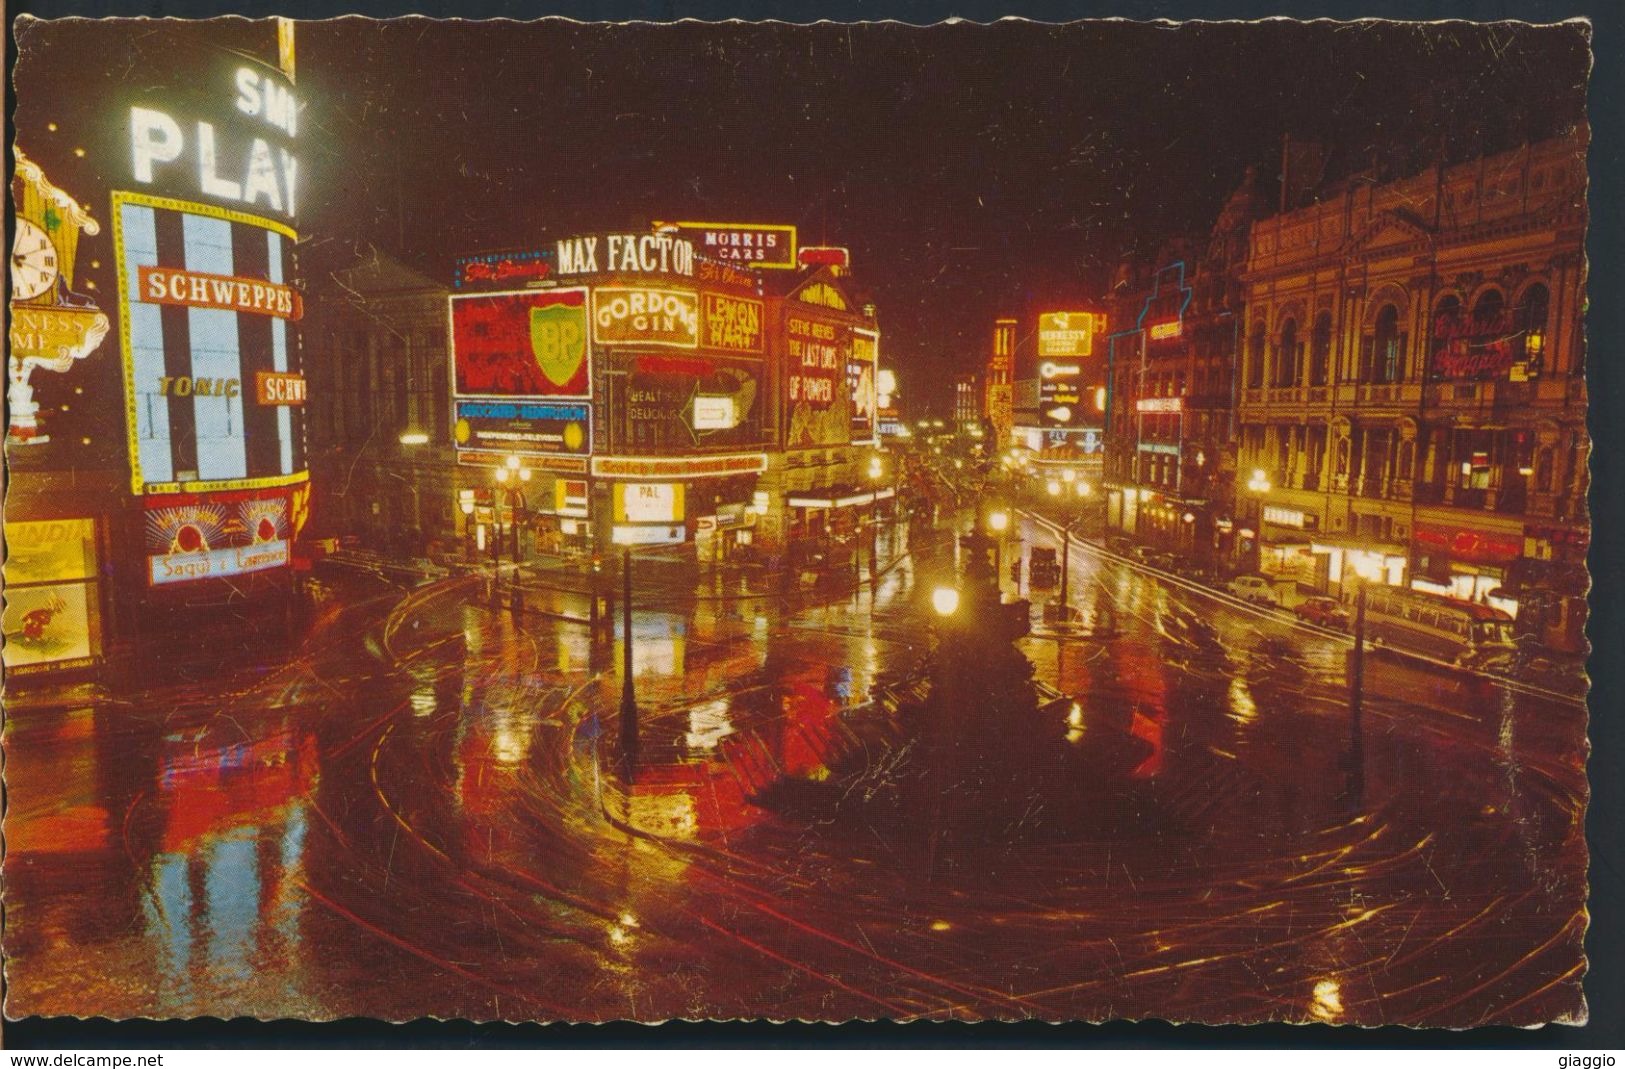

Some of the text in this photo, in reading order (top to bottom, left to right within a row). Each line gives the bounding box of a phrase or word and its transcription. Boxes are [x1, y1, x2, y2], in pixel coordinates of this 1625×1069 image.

[705, 232, 777, 247] MORRIS
[557, 236, 598, 274] MAX
[607, 234, 693, 276] FACTOR
[719, 248, 764, 260] CARS
[149, 272, 292, 313] SCHWEPPES
[633, 315, 675, 332] GIN
[706, 294, 759, 334] LEMON
[540, 319, 580, 363] BP
[802, 343, 820, 368] LAST
[158, 376, 241, 397] TONIC
[789, 375, 801, 401] OF
[639, 485, 661, 499] PAL
